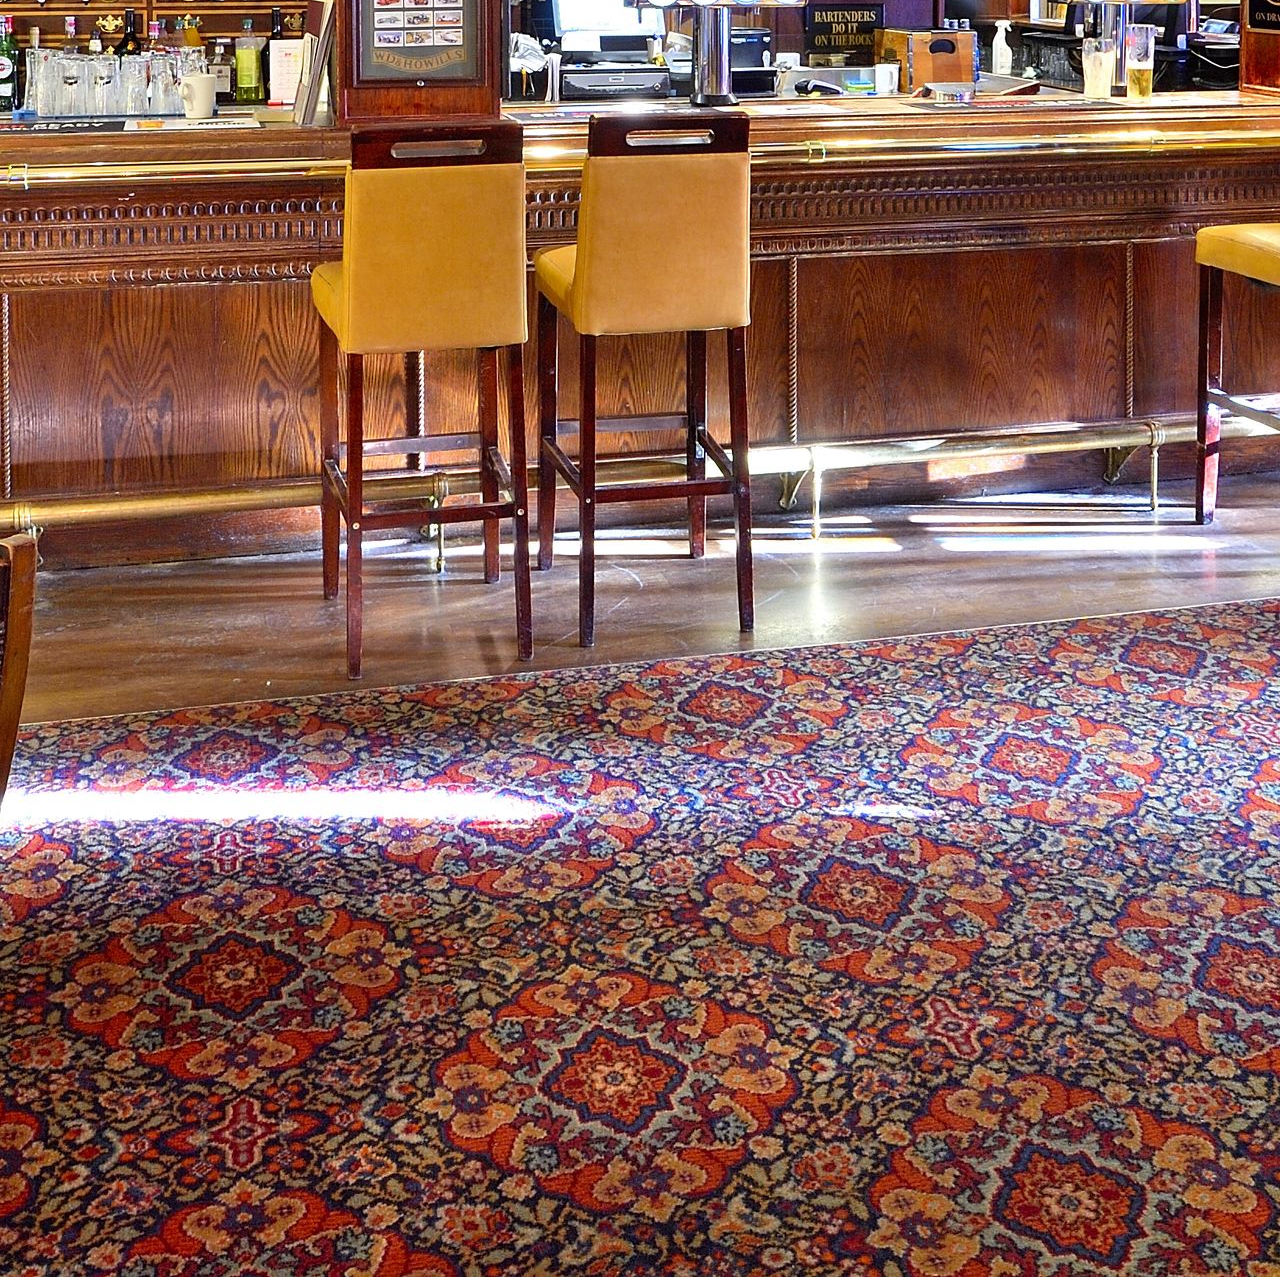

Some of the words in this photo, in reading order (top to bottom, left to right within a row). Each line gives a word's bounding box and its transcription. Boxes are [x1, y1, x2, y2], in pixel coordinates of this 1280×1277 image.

[814, 11, 876, 23] BARTENDERS
[1255, 12, 1266, 21] ON
[832, 23, 845, 34] DO
[848, 23, 858, 34] IT
[815, 35, 828, 47] ON
[830, 34, 847, 46] THE
